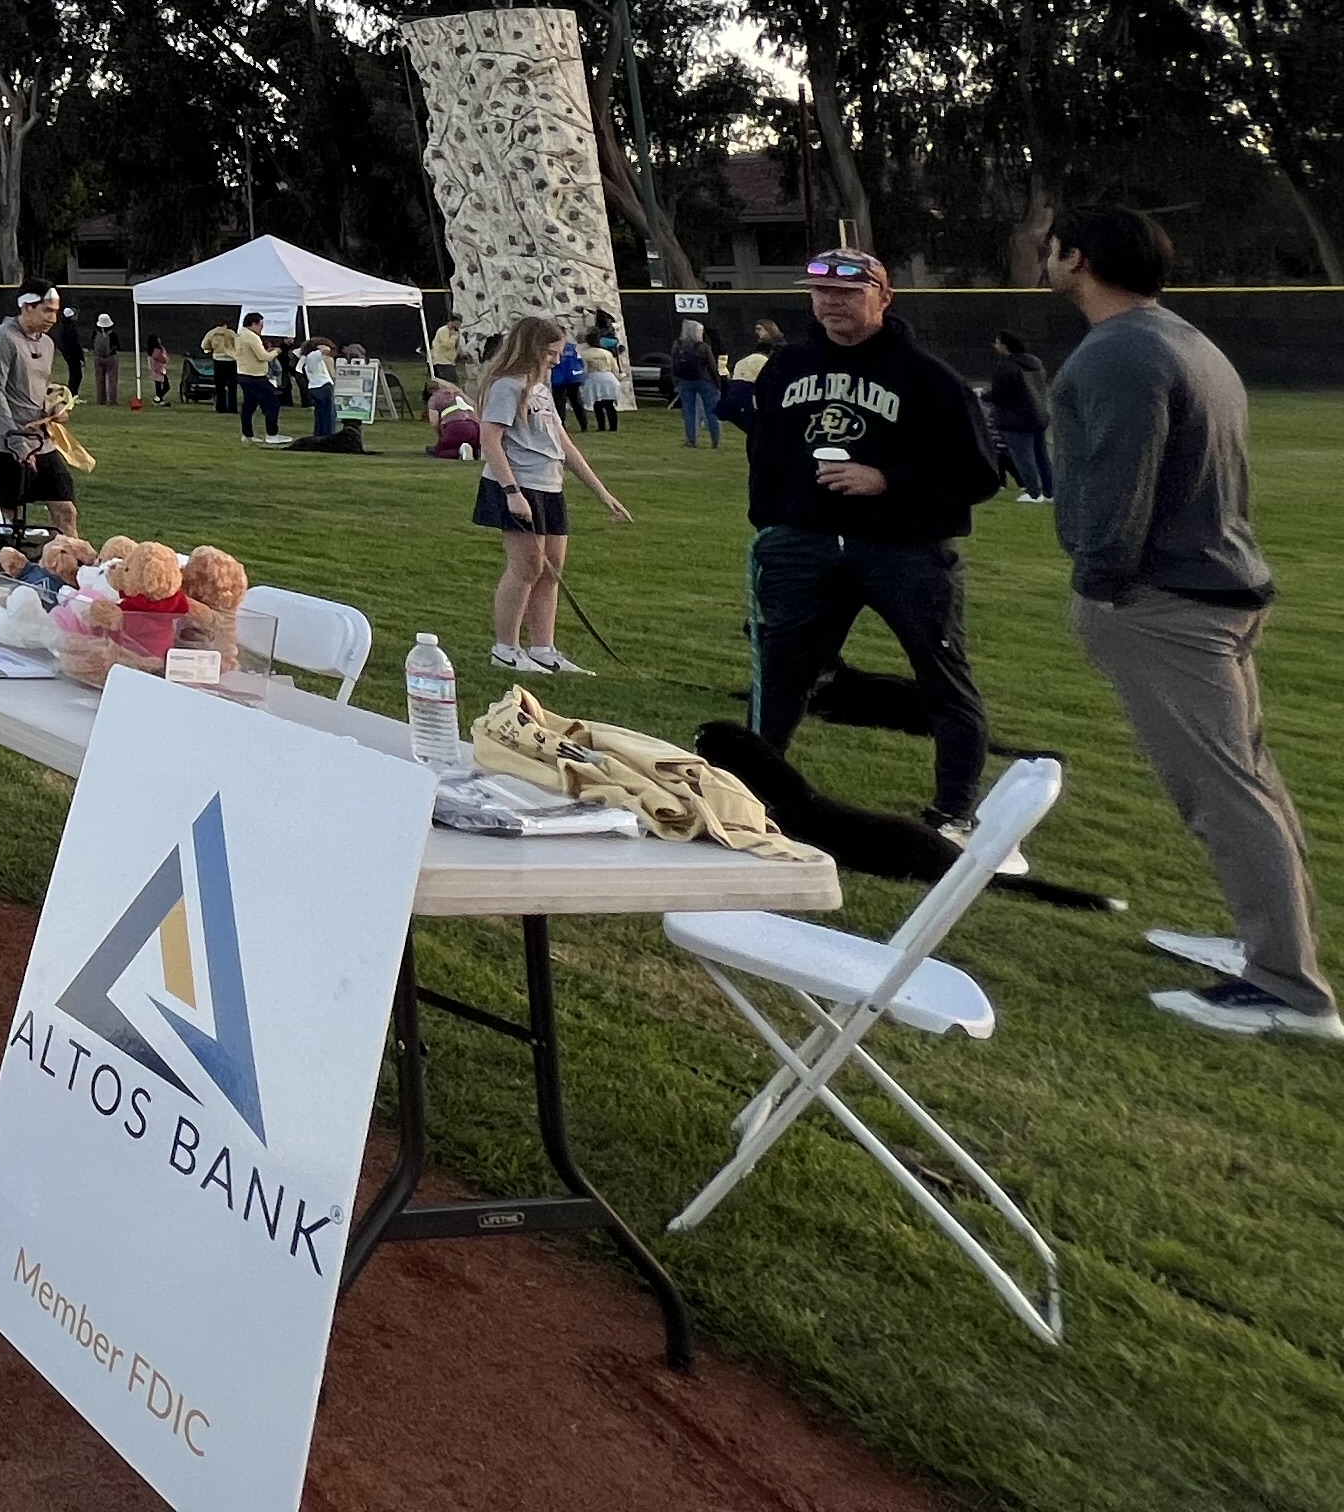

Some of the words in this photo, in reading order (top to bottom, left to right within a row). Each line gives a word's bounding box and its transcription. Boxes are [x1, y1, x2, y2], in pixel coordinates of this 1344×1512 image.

[677, 297, 706, 309] 375
[781, 373, 900, 423] COLORADO
[9, 1010, 152, 1140] ALTOS
[168, 1114, 332, 1278] BANK
[13, 1245, 124, 1373] Member
[127, 1351, 211, 1458] FDIC
